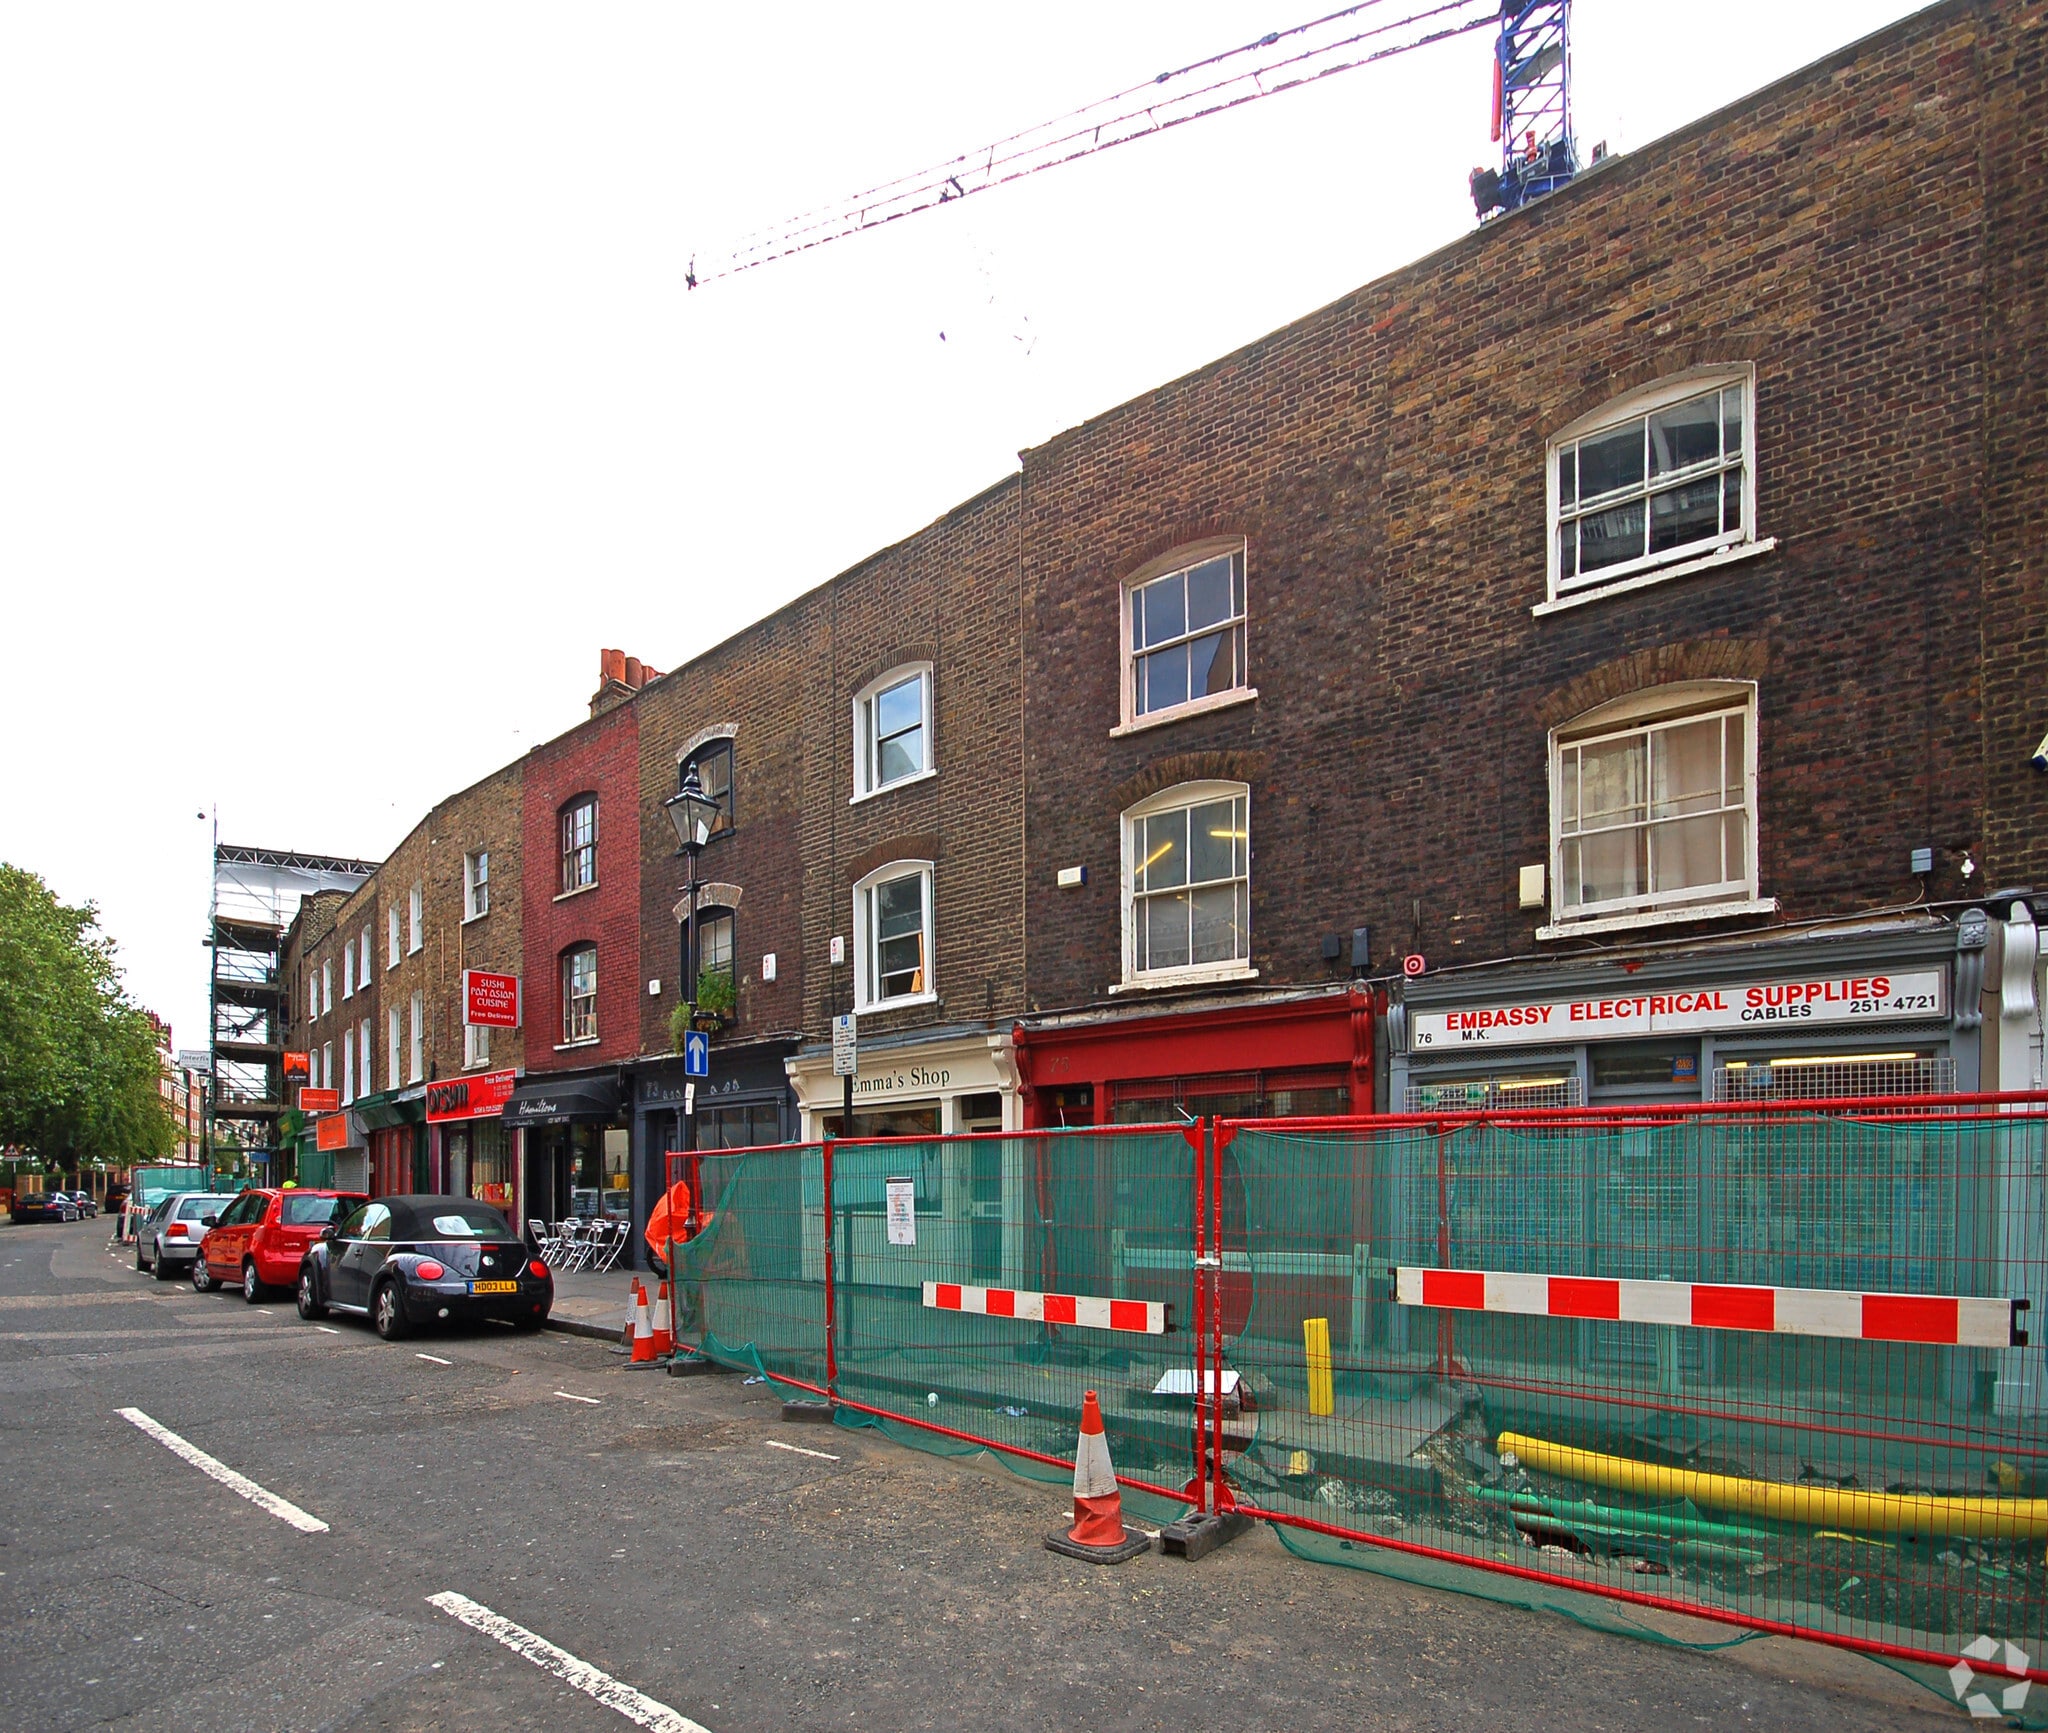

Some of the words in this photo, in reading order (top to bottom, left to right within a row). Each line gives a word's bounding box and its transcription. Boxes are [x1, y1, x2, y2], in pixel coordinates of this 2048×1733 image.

[481, 978, 505, 989] SUSHI
[470, 987, 488, 997] PAN
[489, 989, 515, 1000] ASIAN
[476, 997, 509, 1009] CUISINE
[1446, 1006, 1552, 1031] EMBASSY
[1569, 991, 1729, 1022] ELECTRICAL
[1746, 976, 1890, 1008] SUPPLIES
[470, 1010, 486, 1018] Free
[487, 1011, 514, 1021] Delivery
[1741, 1004, 1812, 1021] CABLES
[1417, 1033, 1432, 1044] 76
[1461, 1029, 1490, 1041] M.K.
[852, 1069, 904, 1093] Emma's
[911, 1066, 950, 1087] Shop
[475, 1282, 498, 1291] HD03
[500, 1282, 515, 1291] LLA
